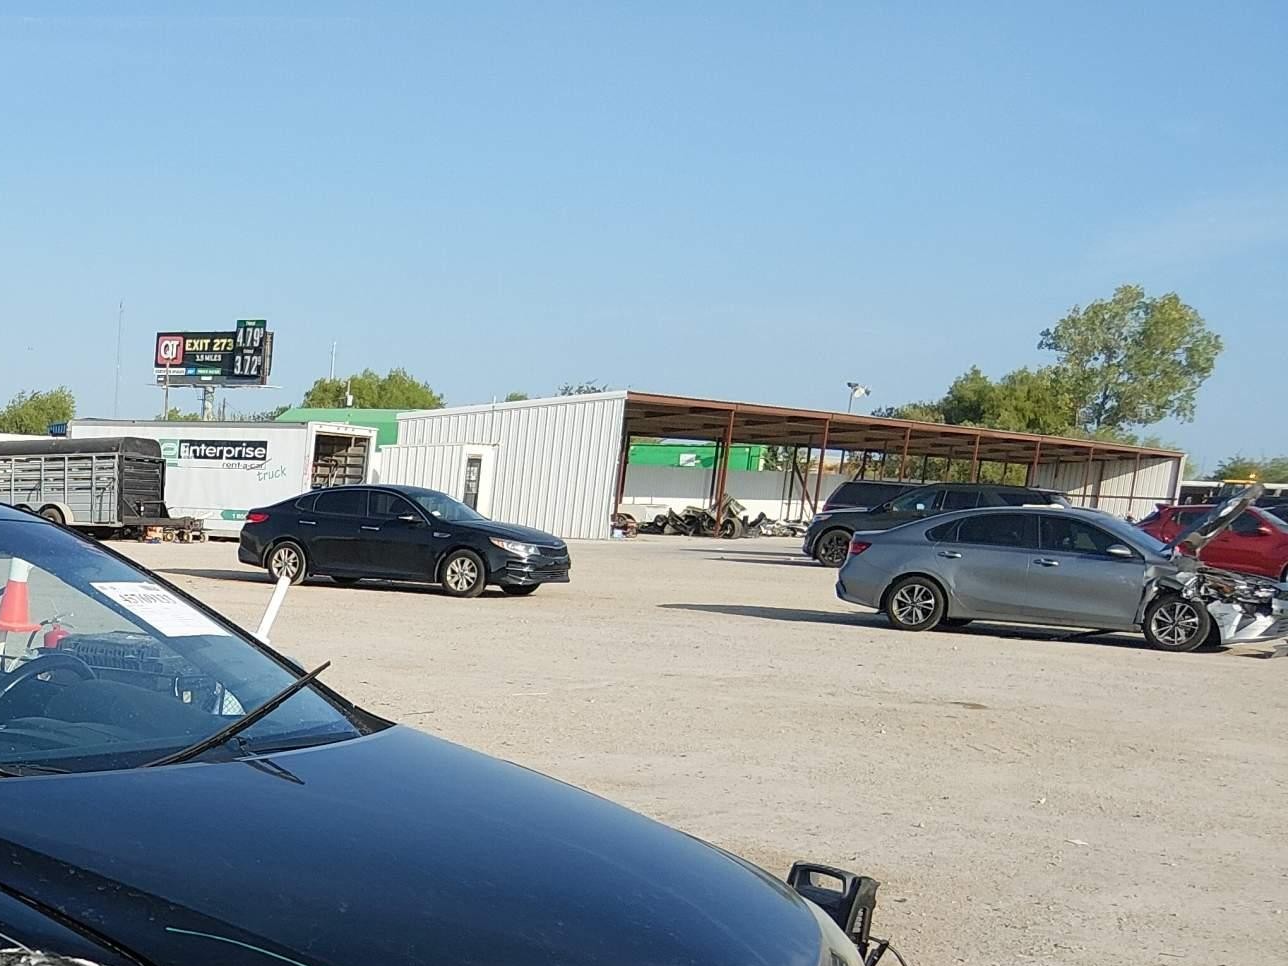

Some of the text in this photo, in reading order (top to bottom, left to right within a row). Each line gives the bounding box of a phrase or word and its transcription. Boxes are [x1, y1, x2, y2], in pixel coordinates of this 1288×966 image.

[160, 341, 179, 360] QT
[185, 339, 233, 351] EXIT 273
[181, 443, 266, 460] Enterprise
[257, 465, 286, 481] truck
